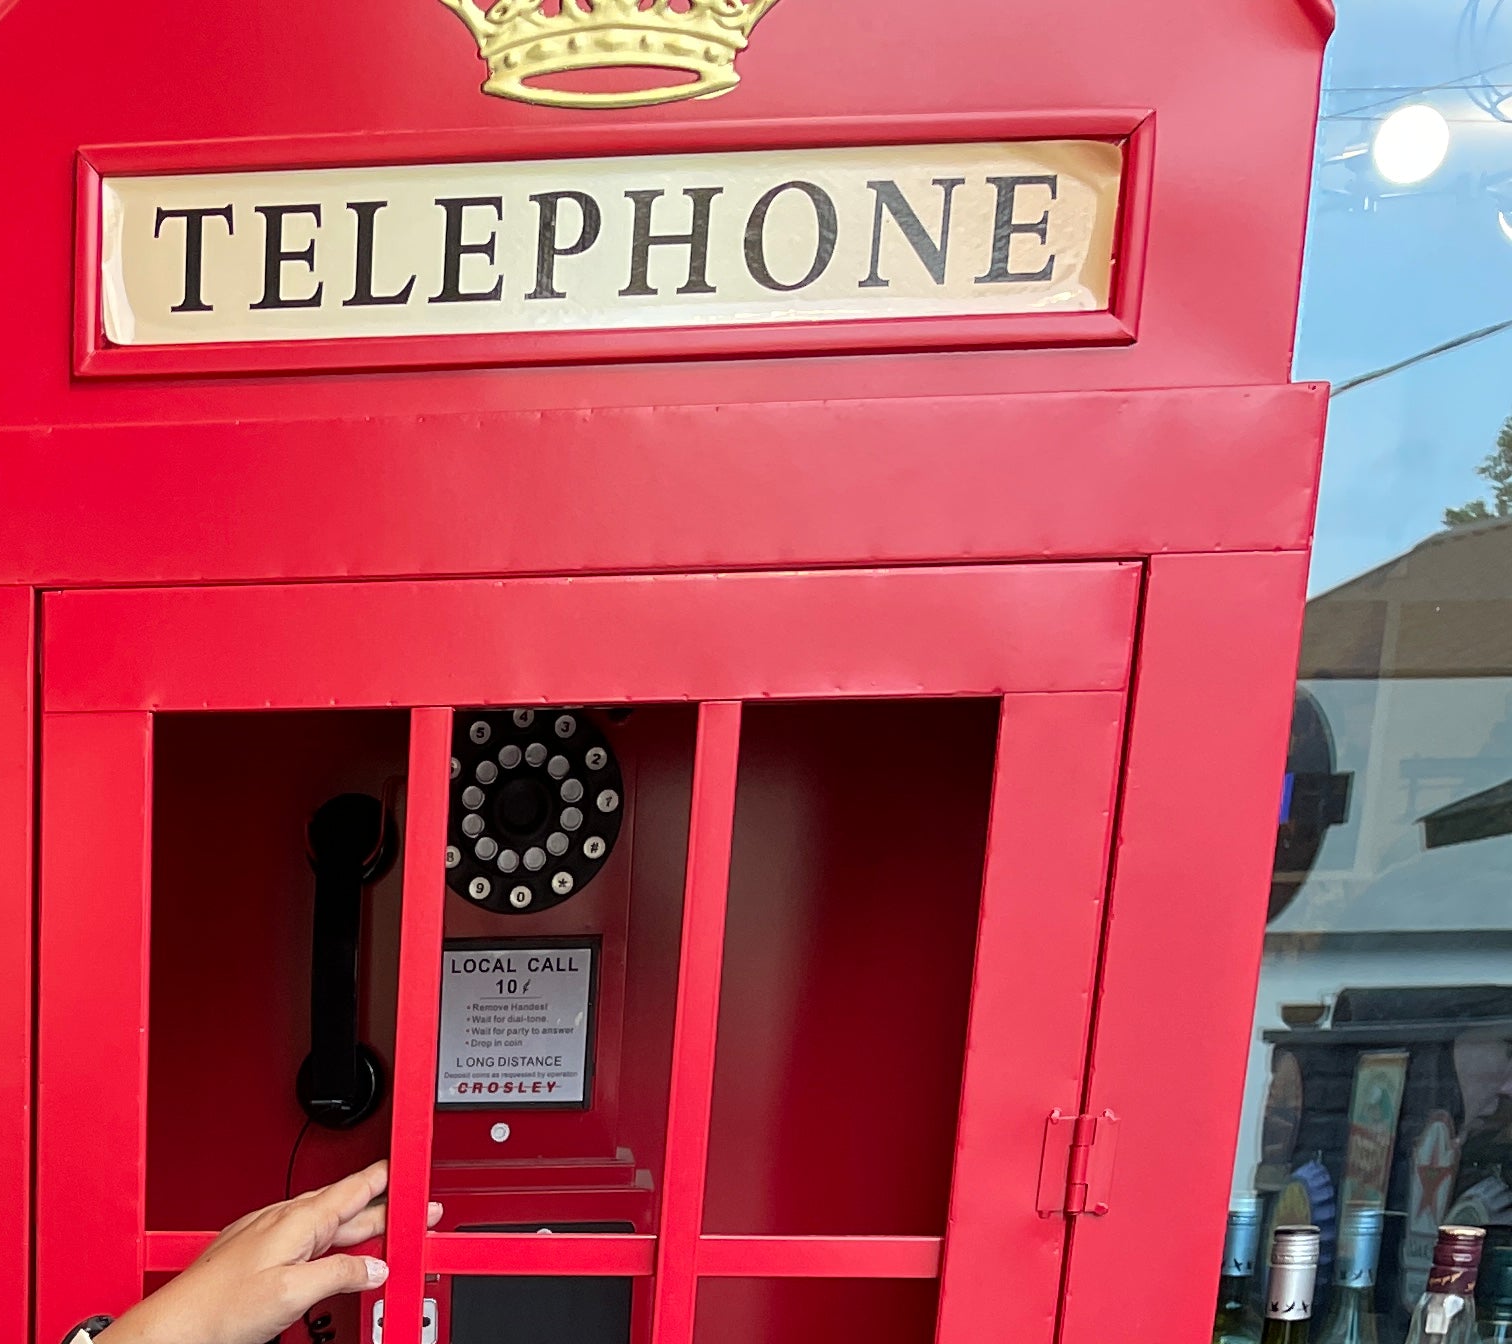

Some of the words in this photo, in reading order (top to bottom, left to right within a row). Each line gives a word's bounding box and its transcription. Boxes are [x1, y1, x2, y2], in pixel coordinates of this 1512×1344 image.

[152, 172, 1061, 314] TELEPHONE
[519, 710, 528, 721] 4
[476, 727, 485, 739] 5
[561, 721, 570, 733] 3
[591, 753, 601, 765] 2
[476, 882, 484, 894] 9
[517, 891, 525, 903] 0
[451, 958, 517, 974] LOCAL
[527, 957, 579, 972] CALL
[495, 979, 517, 994] 10
[471, 1015, 491, 1023] Wait
[493, 1015, 505, 1023] for
[471, 1027, 491, 1035] Wait
[492, 1027, 505, 1035] for
[506, 1028, 529, 1037] party
[470, 1039, 492, 1048] Drop
[494, 1039, 502, 1047] in
[504, 1039, 523, 1047] coin
[456, 1056, 495, 1068] LONG
[498, 1056, 562, 1067] DISTANCE
[457, 1081, 557, 1094] CROSLEY
